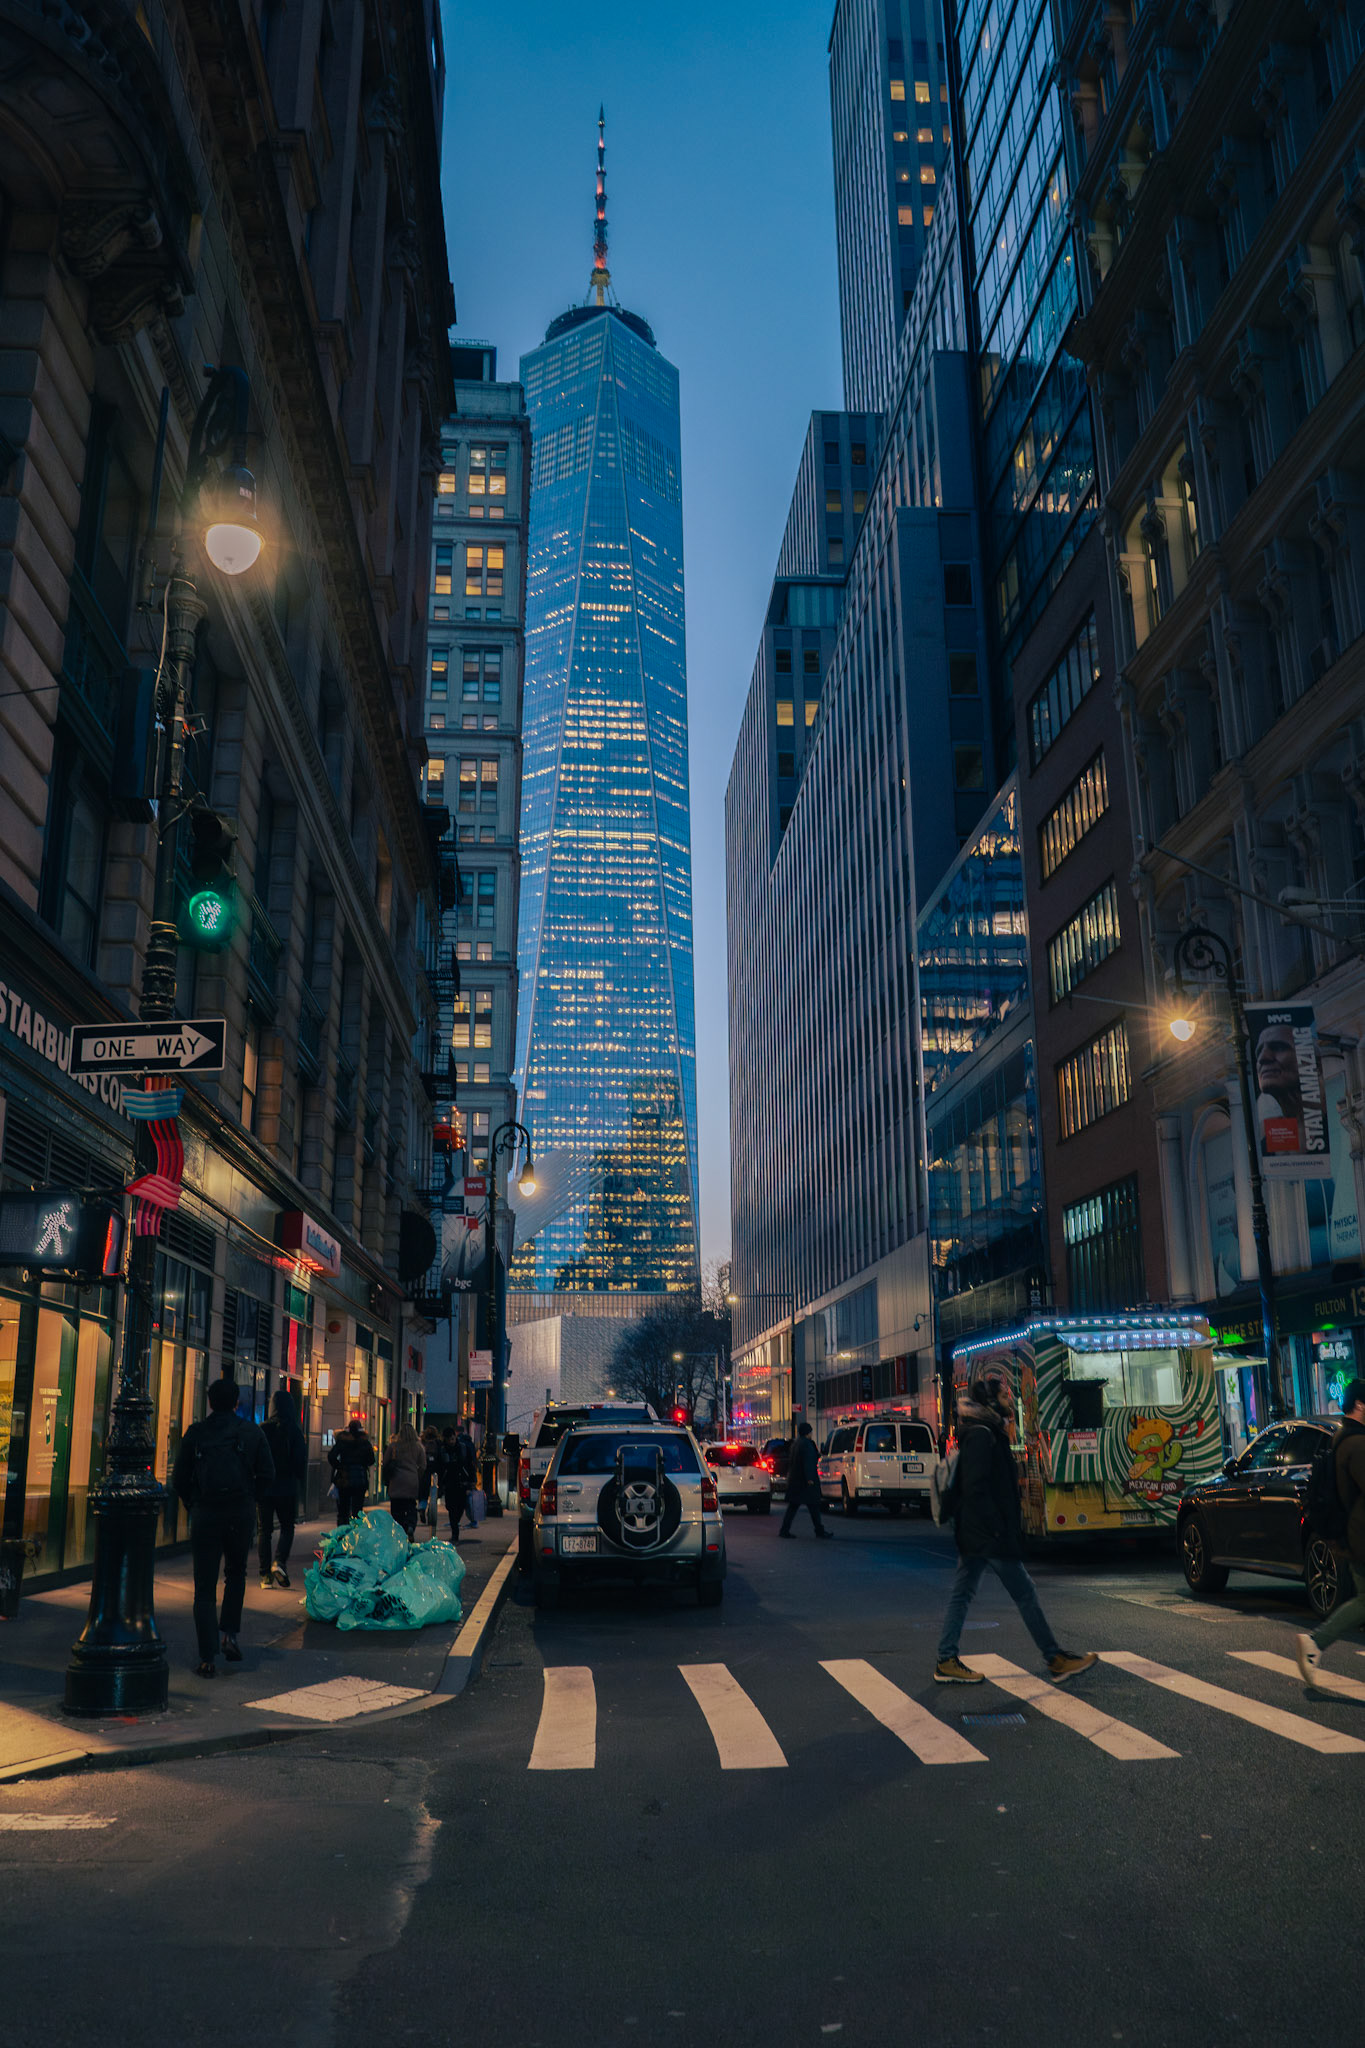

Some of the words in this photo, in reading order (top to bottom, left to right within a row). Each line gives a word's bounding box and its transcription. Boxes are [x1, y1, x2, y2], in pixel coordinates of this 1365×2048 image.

[1268, 1014, 1292, 1024] NYC
[94, 1040, 136, 1058] ONE
[157, 1037, 200, 1056] WAY
[1292, 1026, 1322, 1104] AMAZING
[1303, 1106, 1326, 1152] STAY
[455, 1277, 472, 1290] bgc
[1314, 1298, 1347, 1317] FULTON
[1128, 1481, 1159, 1492] MEXICAN
[1160, 1482, 1177, 1492] FOOD
